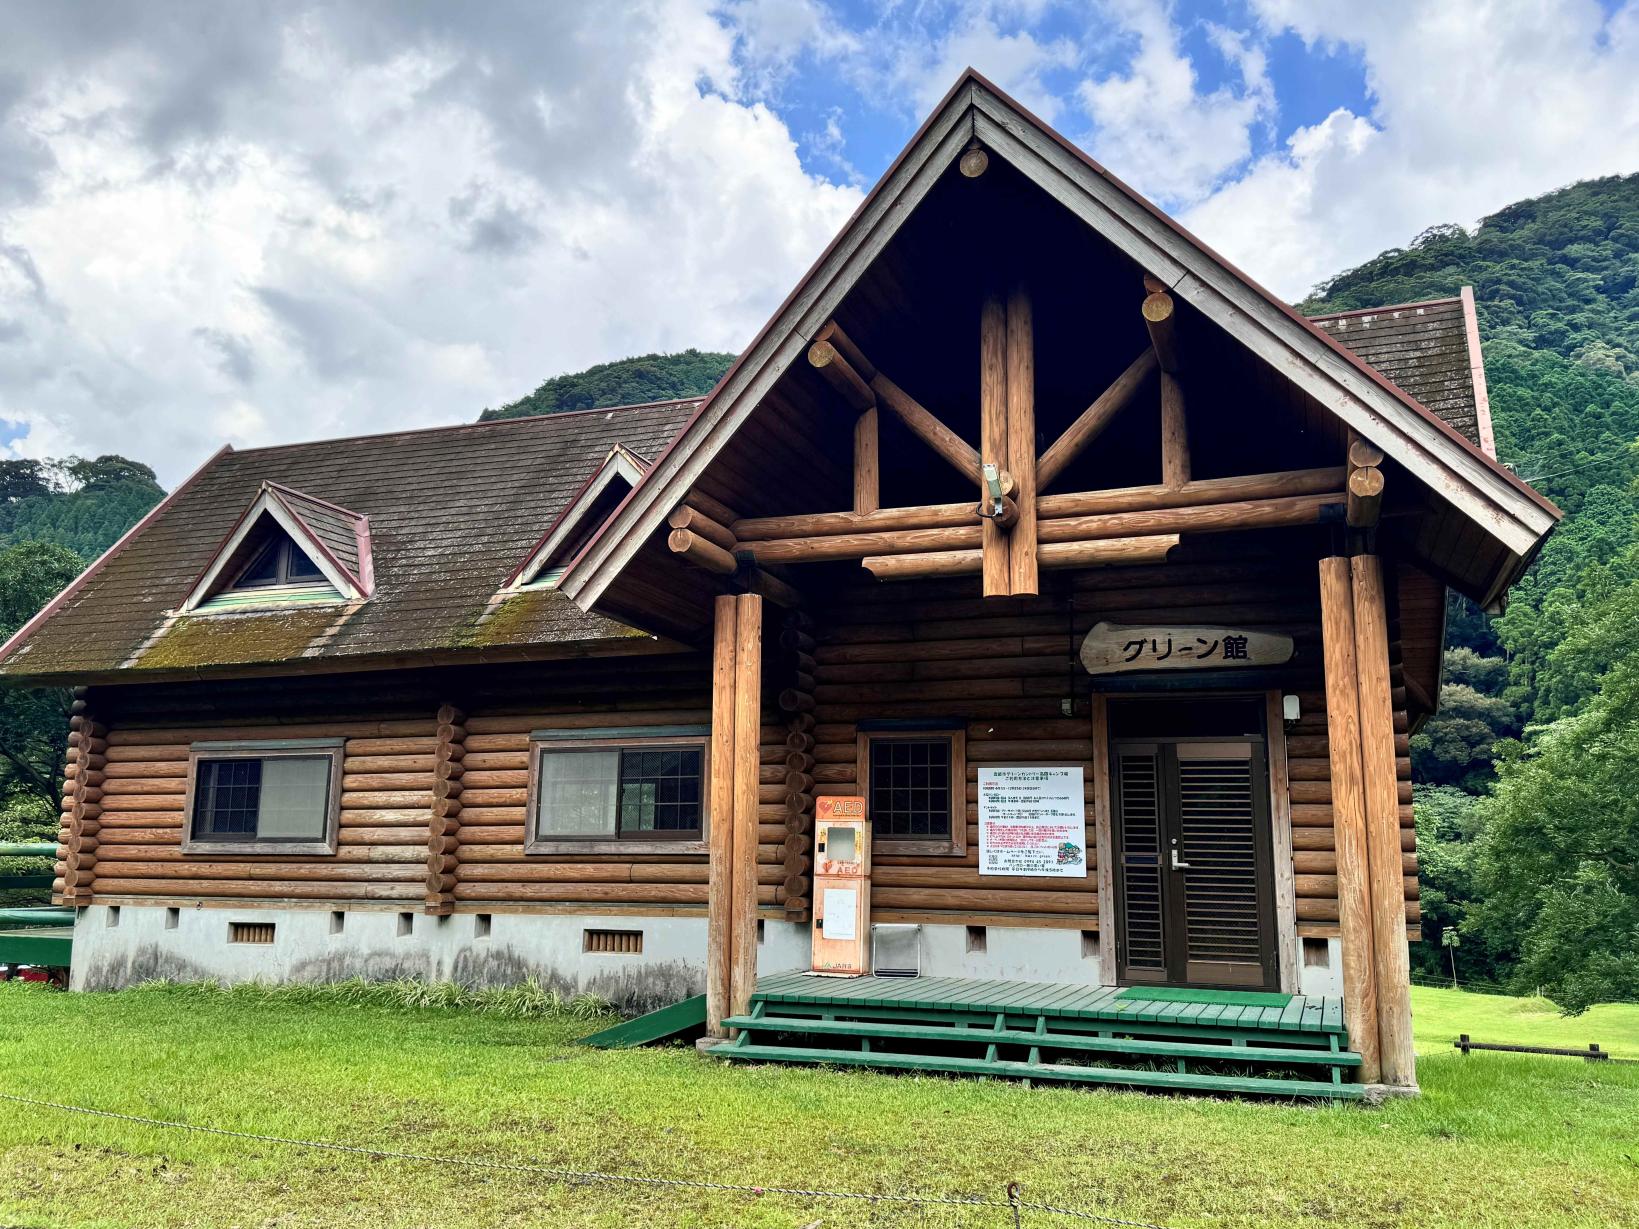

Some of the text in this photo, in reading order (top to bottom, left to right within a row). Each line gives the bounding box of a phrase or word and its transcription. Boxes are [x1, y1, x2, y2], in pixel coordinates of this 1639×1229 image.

[1123, 635, 1248, 662] グリーン館
[832, 800, 864, 814] AED
[837, 866, 857, 874] AED
